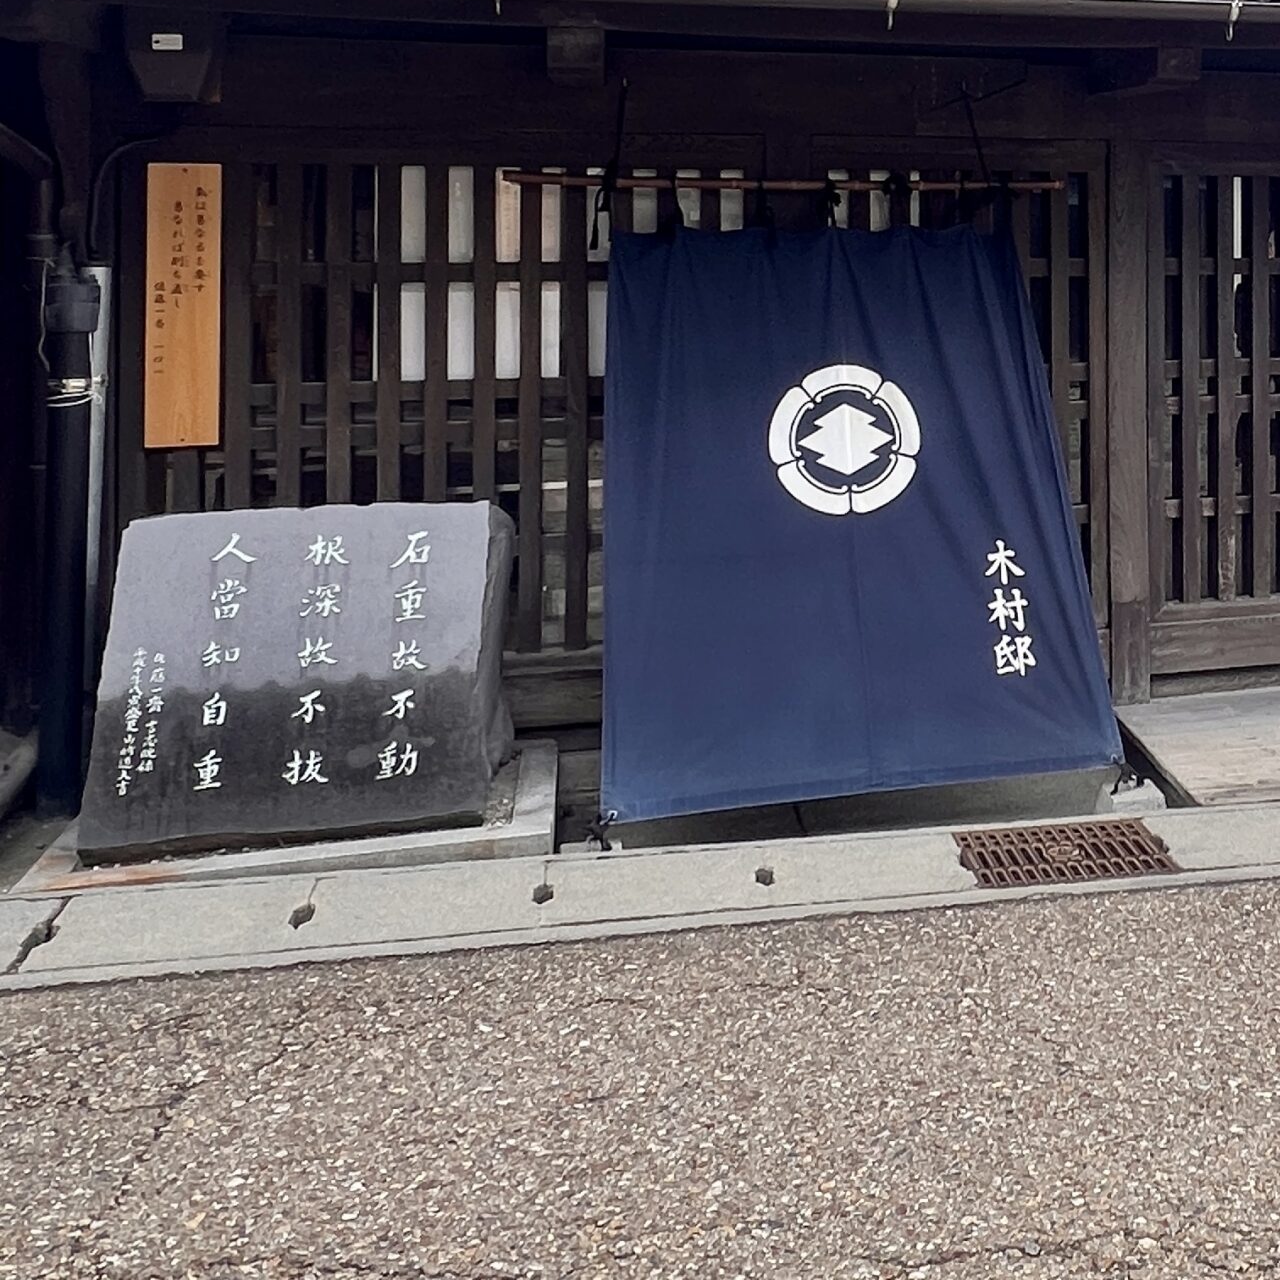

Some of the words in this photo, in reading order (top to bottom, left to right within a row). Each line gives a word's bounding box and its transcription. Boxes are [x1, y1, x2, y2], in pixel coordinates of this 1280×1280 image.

[375, 530, 432, 782] 石重故不動
[985, 539, 1037, 677] 木村邸
